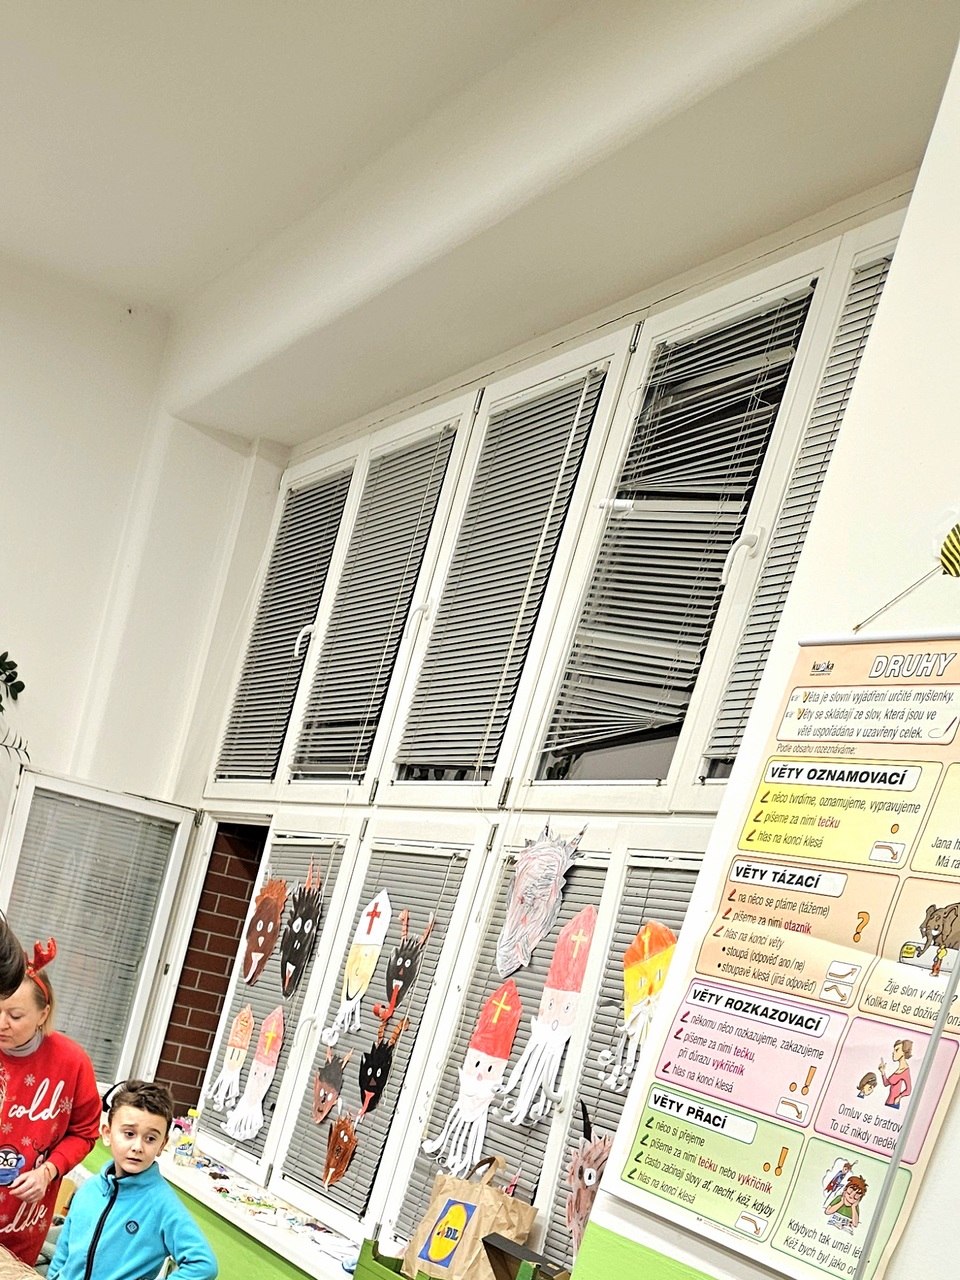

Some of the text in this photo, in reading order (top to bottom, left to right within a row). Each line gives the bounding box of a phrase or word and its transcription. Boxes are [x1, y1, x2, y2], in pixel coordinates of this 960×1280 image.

[869, 653, 957, 678] DRUHY
[802, 690, 954, 704] Věta je slovní vyjádření určité myšlenky.
[797, 708, 936, 722] Věty se skládají ze slov, která jsou ve
[797, 725, 923, 740] větě uspořádána v uzavřený celek.
[776, 743, 791, 753] Podle
[793, 743, 813, 753] obsahu
[771, 764, 908, 785] VĚTY OZNAMOVACÍ
[771, 791, 921, 814] něco tvrdíme, oznamujeme, vypravujeme
[763, 811, 841, 829] píšeme za nimi tečku
[757, 831, 824, 848] hlas na konci klesá
[931, 836, 952, 849] Jana
[935, 855, 951, 868] Má
[735, 864, 822, 888] VĚTY TÁZACÍ
[738, 892, 830, 918] na něco se ptáme (tážeme)
[732, 910, 813, 934] píšeme za nimi otazník
[723, 927, 785, 950] hlas na konci věty
[726, 945, 749, 959] stoupá
[721, 961, 751, 977] stoupavě
[752, 966, 770, 982] klesá
[884, 978, 899, 995] Žije
[900, 985, 918, 998] slon
[920, 990, 926, 999] v
[692, 988, 824, 1032] VĚTY ROZKAZOVACÍ
[865, 994, 888, 1009] Kolika
[889, 1000, 901, 1012] let
[901, 1004, 912, 1014] se
[913, 1005, 940, 1021] dožívá
[683, 1031, 755, 1062] píšeme za nimi tečku,
[690, 1014, 824, 1060] někomu něco rozkazujeme, zakazujeme
[678, 1046, 746, 1076] při důrazu vykřičník
[672, 1063, 735, 1093] hlas na konci klesá
[8, 1078, 64, 1121] cold
[653, 1094, 728, 1129] VĚTY PŘACÍ
[838, 1103, 903, 1133] Omluv se bratrov
[655, 1120, 705, 1147] něco si přejeme
[830, 1118, 838, 1132] To
[840, 1123, 850, 1134] už
[851, 1127, 872, 1144] nikdy
[650, 1137, 773, 1195] píšeme za nimi tečku nebo vykřičník
[637, 1170, 696, 1205] hlas na konci klesá
[644, 1153, 776, 1218] často začínají slovy ať, nechť, kéž, kdyby
[787, 1218, 818, 1240] Kdybych
[819, 1232, 831, 1246] tak
[832, 1240, 852, 1254] uměl
[783, 1236, 799, 1250] Kéž
[798, 1242, 817, 1258] bych
[817, 1250, 830, 1264] byl
[828, 1256, 846, 1271] jako
